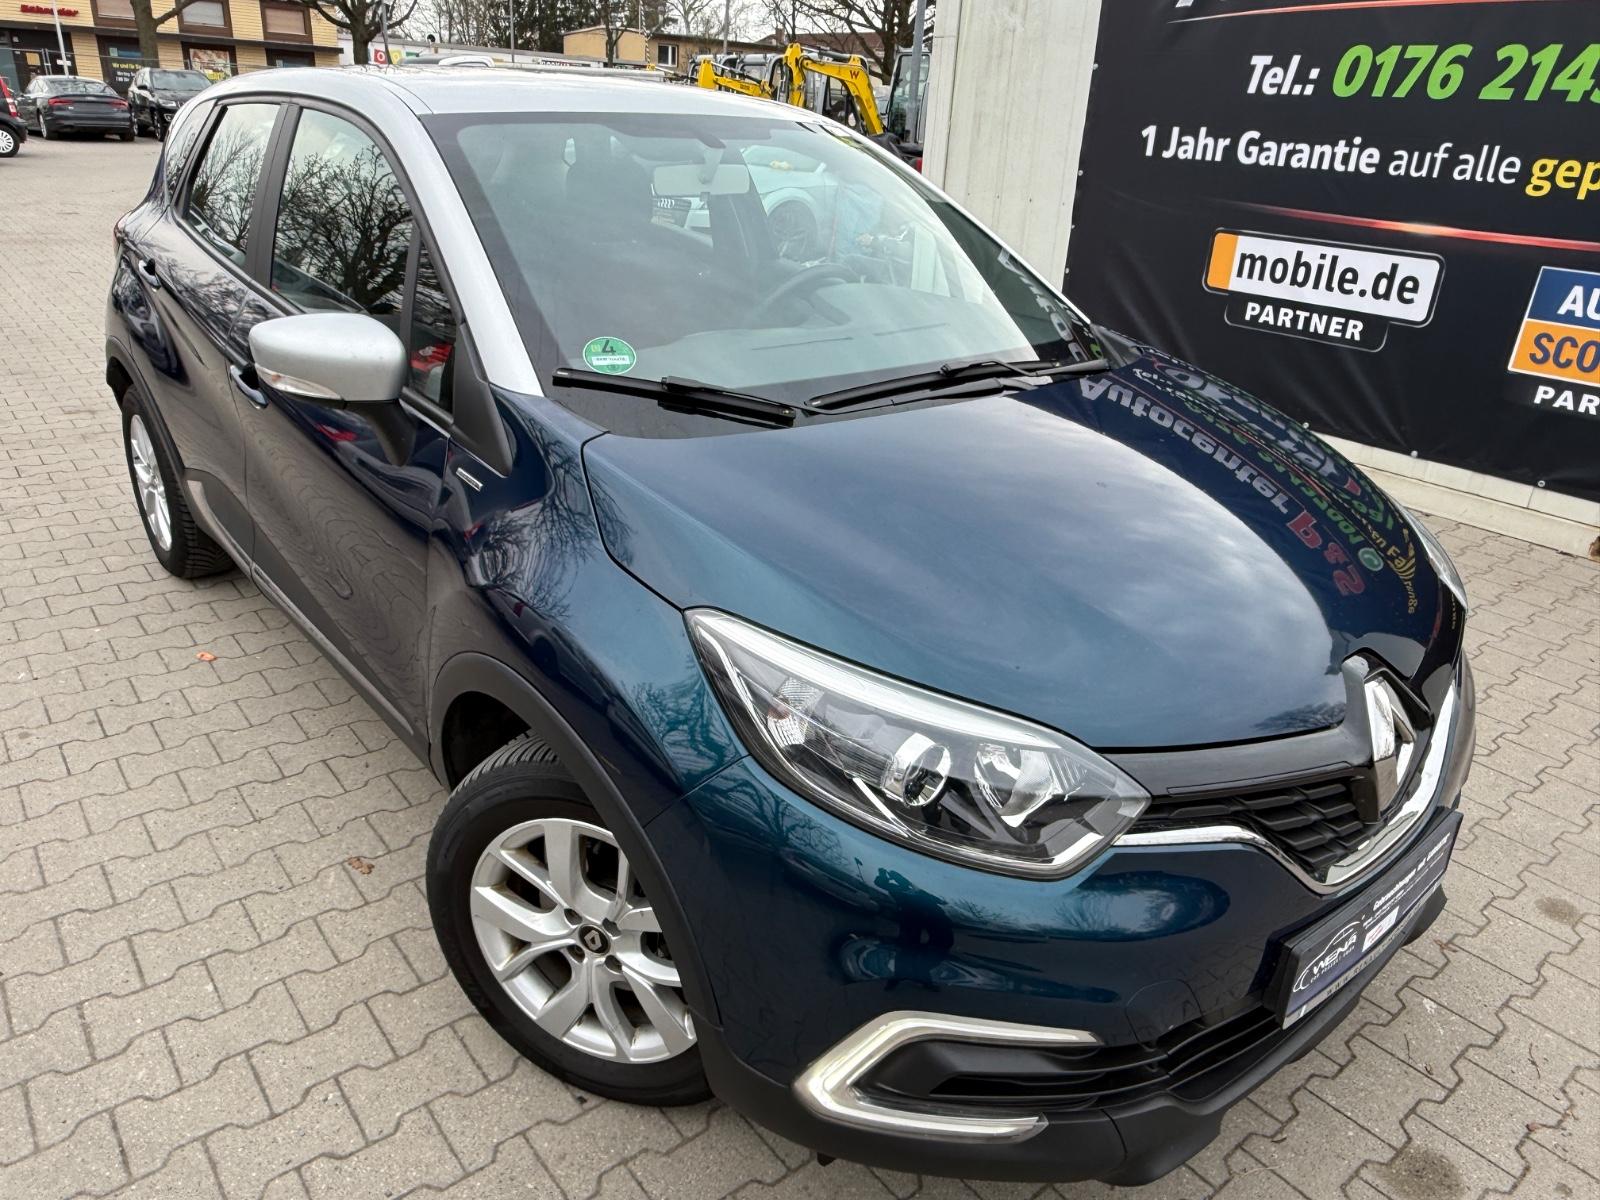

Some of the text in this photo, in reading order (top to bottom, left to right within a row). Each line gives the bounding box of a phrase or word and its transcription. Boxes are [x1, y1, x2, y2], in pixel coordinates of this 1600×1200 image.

[1246, 43, 1600, 103] Tel.: 0176 214
[1141, 125, 1158, 157] 1
[1162, 126, 1230, 162] Jahr
[1237, 130, 1380, 174] Garantie
[1388, 142, 1453, 179] auf
[1452, 144, 1521, 184] alle
[1237, 250, 1420, 305] mobile.de
[1244, 303, 1364, 341] PARTNER
[601, 339, 616, 356] 4
[1529, 332, 1600, 373] SCO
[1534, 385, 1600, 415] PAR
